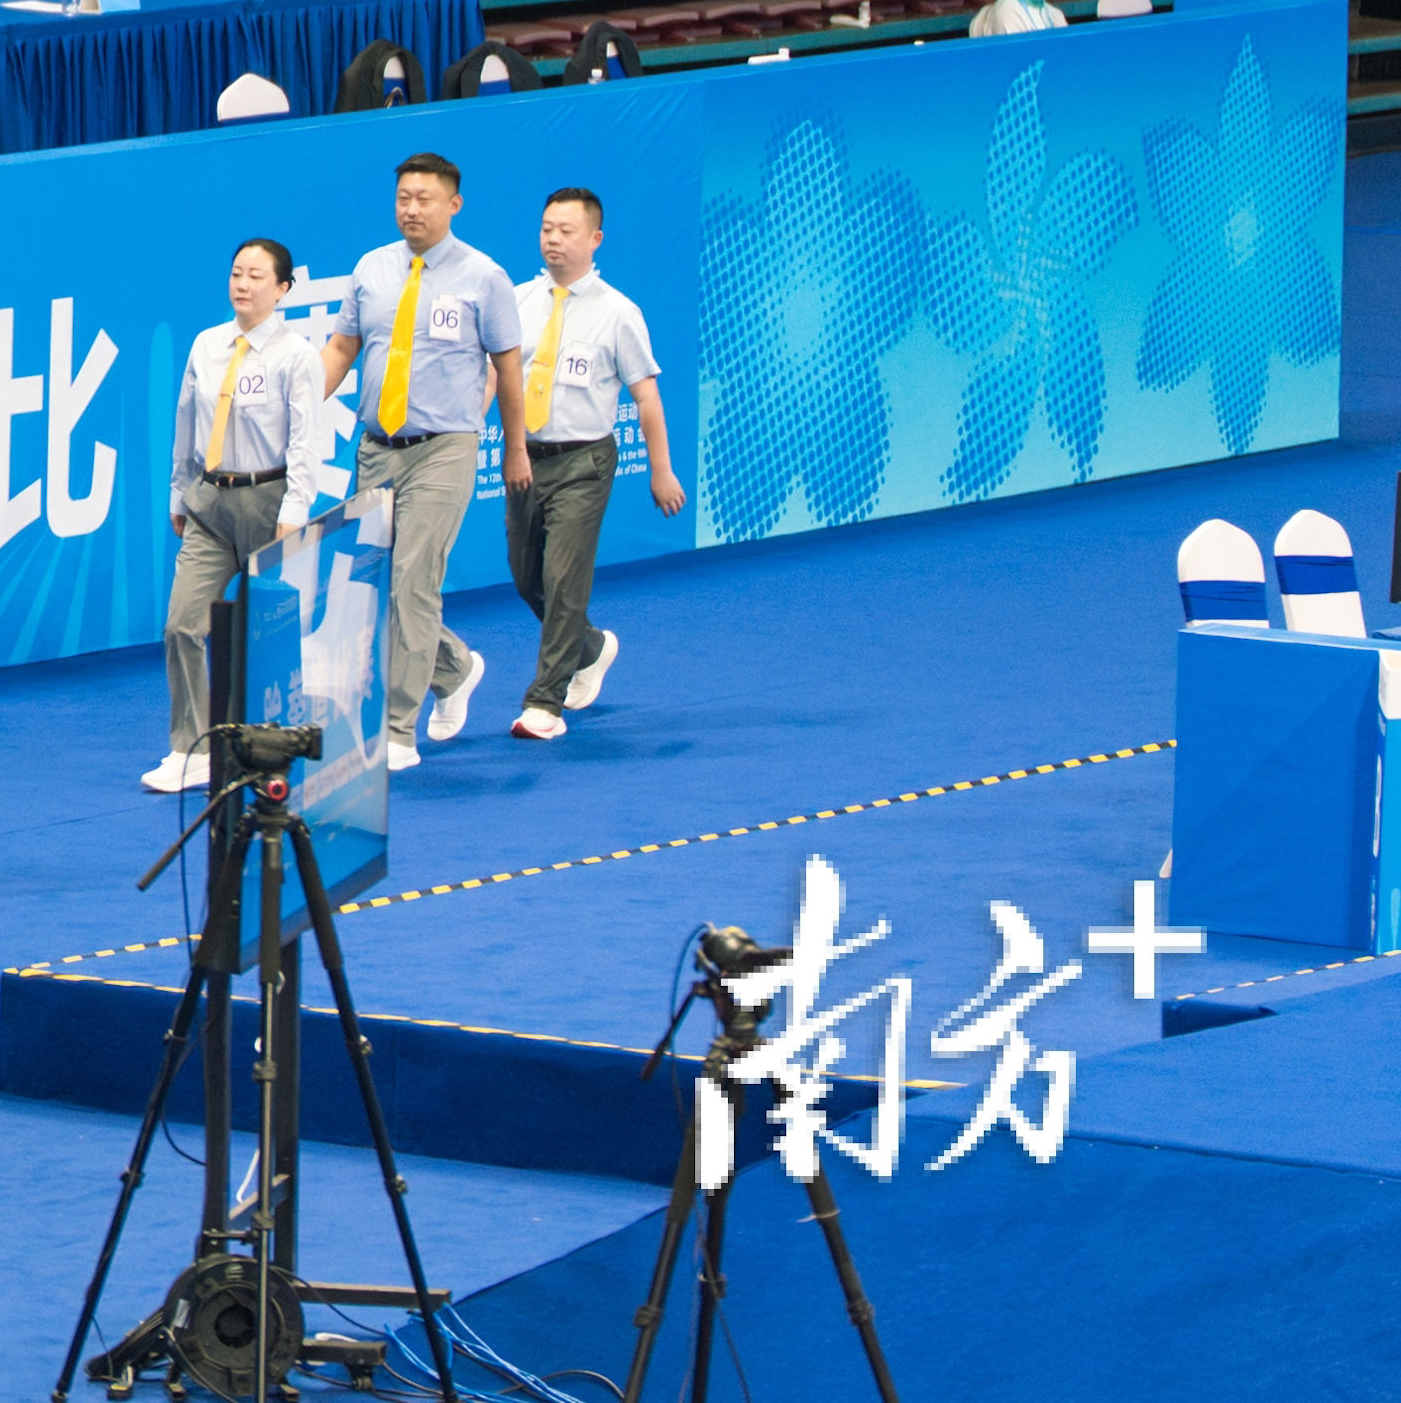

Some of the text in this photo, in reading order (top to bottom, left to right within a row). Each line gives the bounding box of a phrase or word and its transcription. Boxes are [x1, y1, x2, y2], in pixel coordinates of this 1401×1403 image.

[433, 309, 458, 328] 06
[566, 357, 588, 375] 16
[239, 375, 264, 394] 02
